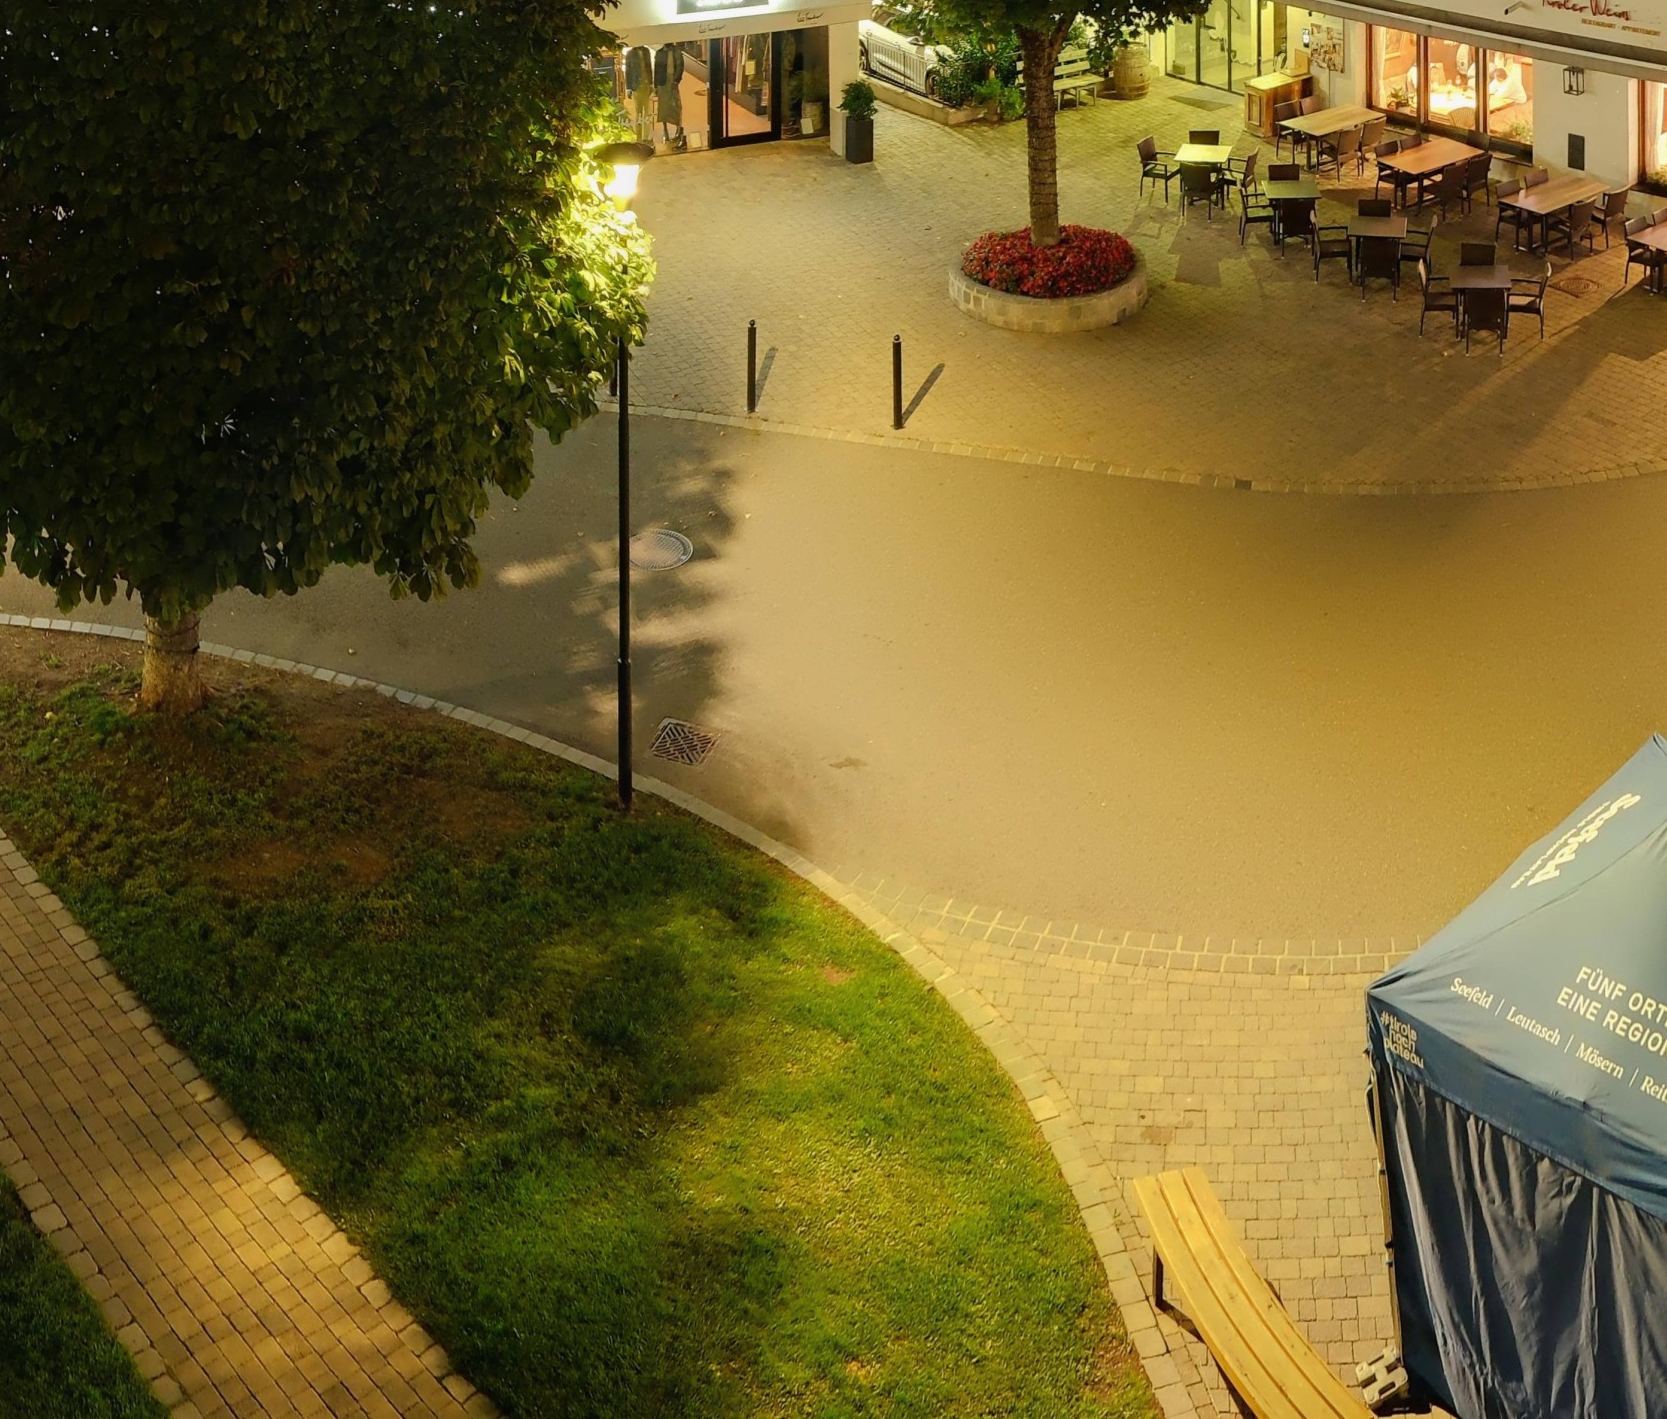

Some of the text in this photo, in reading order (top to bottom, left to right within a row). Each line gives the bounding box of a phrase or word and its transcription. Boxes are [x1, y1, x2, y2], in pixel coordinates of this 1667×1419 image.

[1576, 965, 1627, 1000] FÜNF
[1556, 986, 1602, 1021] EINE
[1450, 977, 1494, 1010] Seefeld
[1506, 1006, 1561, 1046] Leutasch
[1575, 1042, 1624, 1080] Mösern
